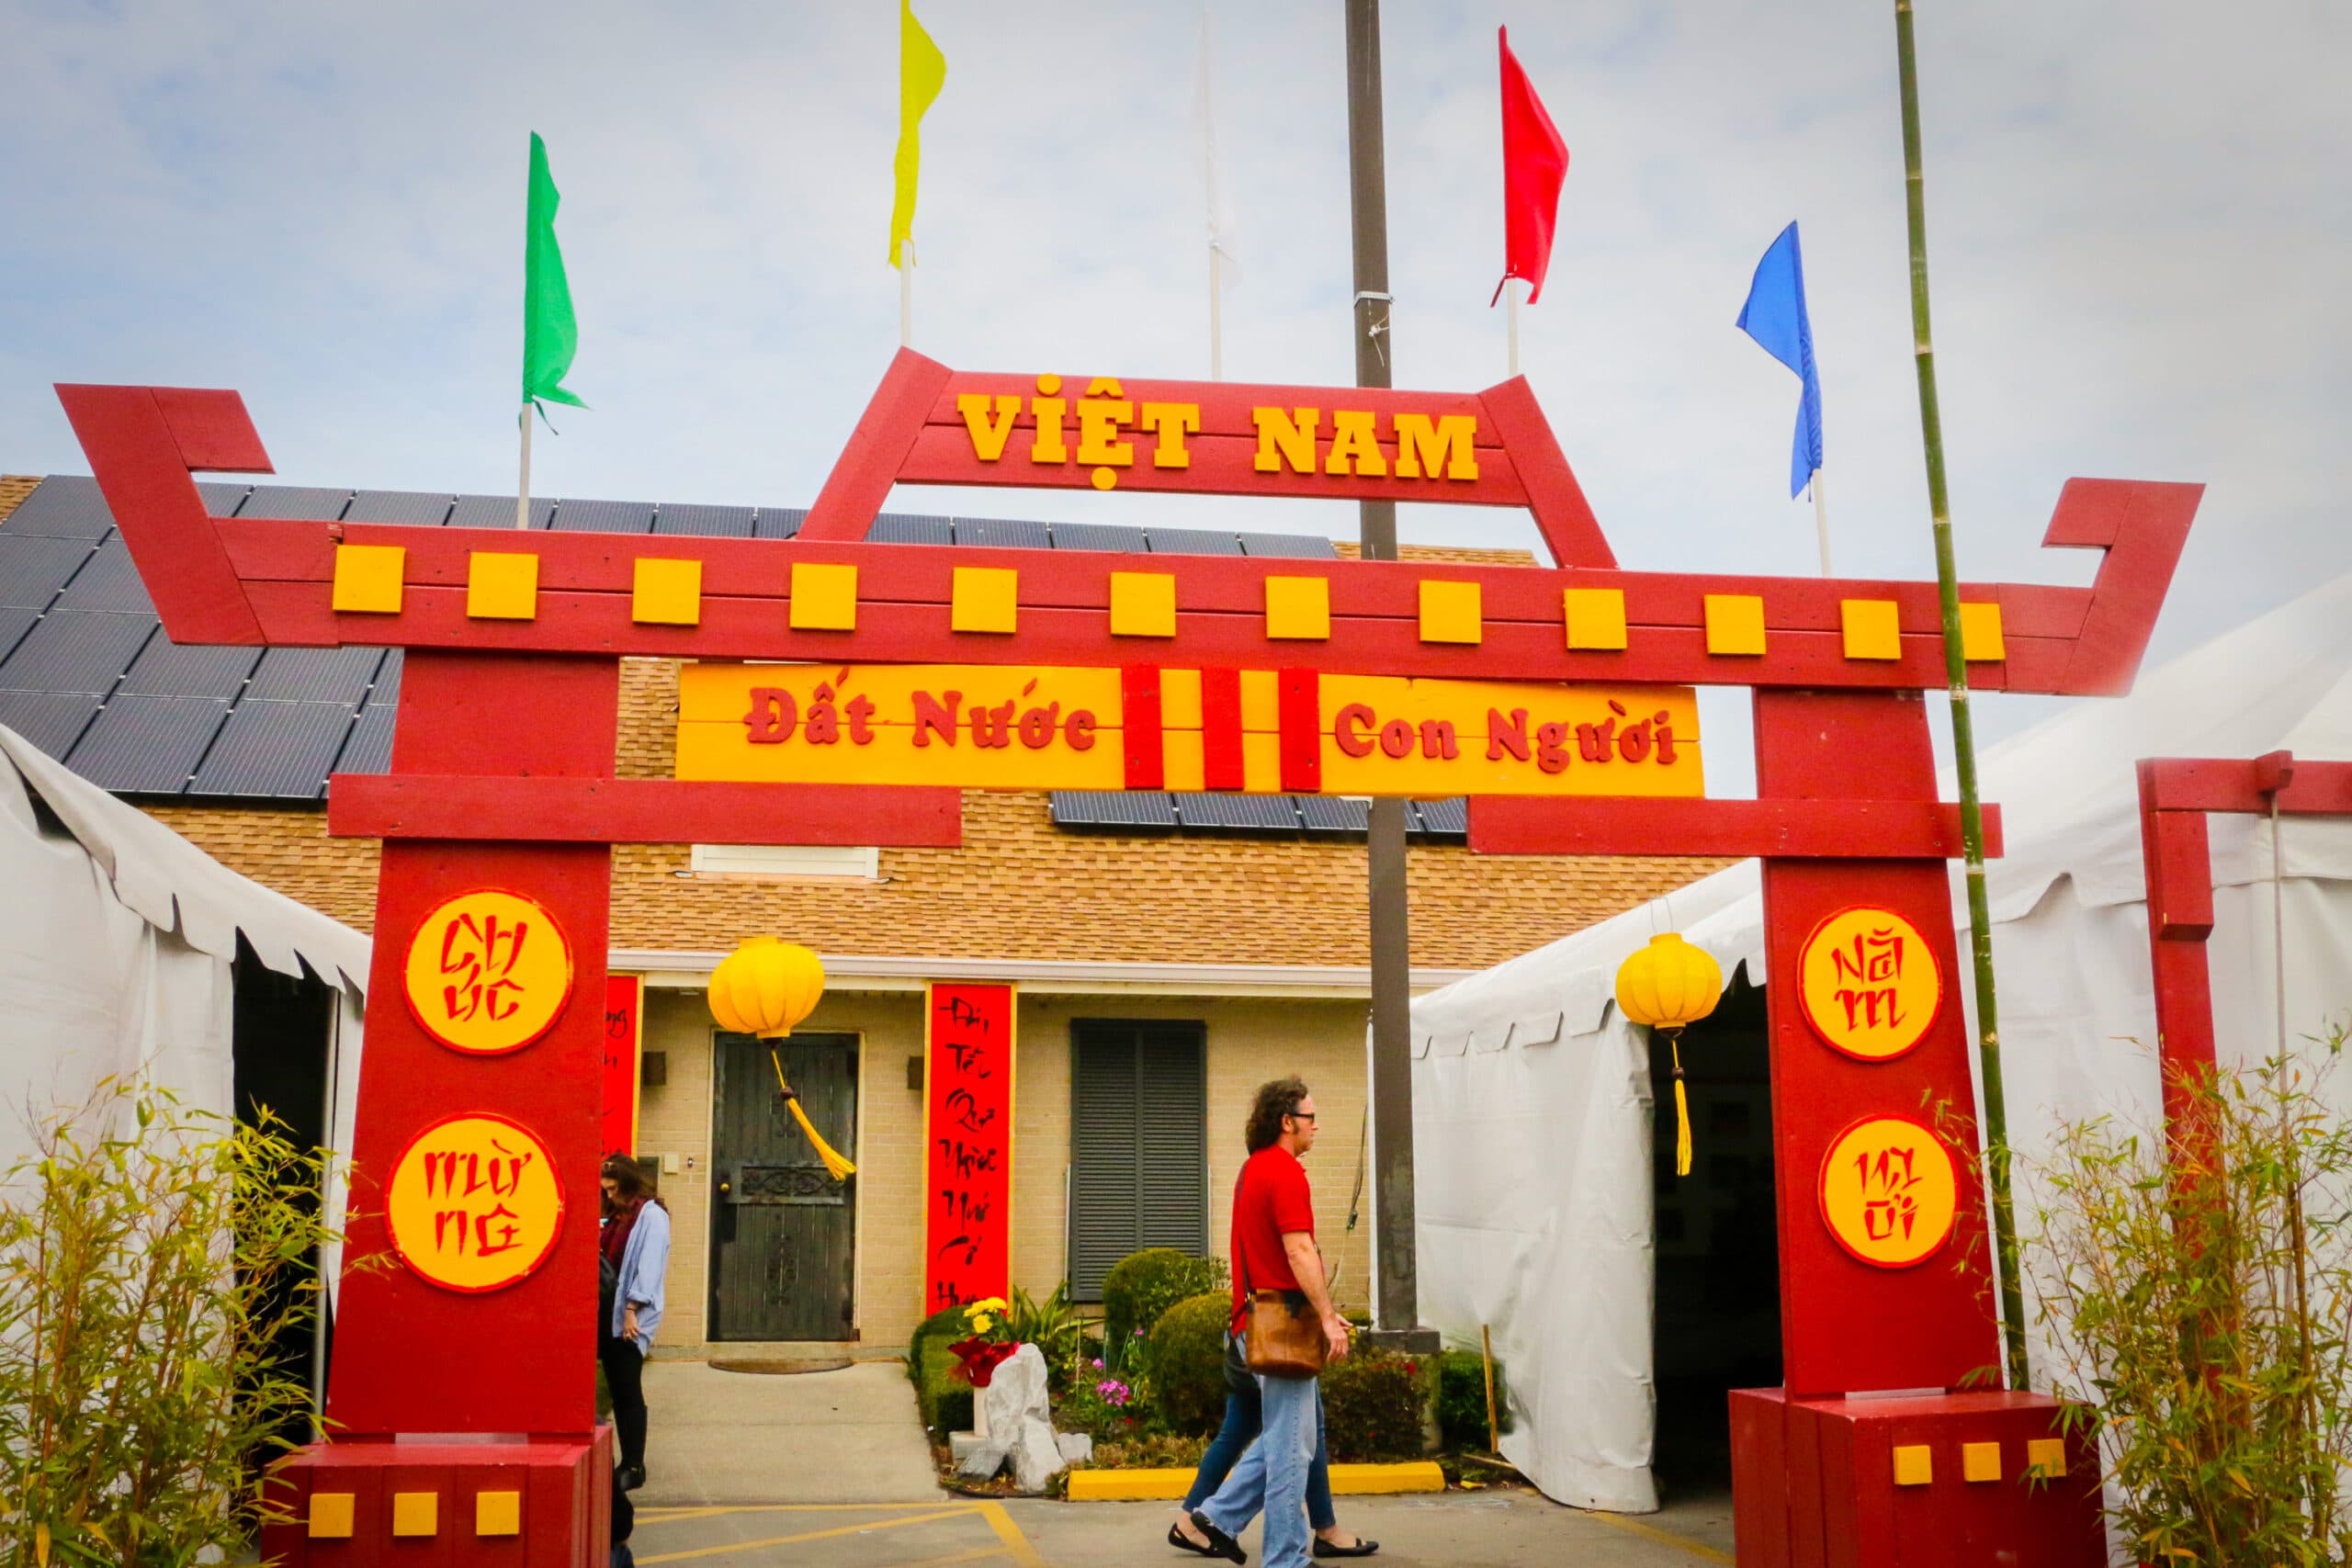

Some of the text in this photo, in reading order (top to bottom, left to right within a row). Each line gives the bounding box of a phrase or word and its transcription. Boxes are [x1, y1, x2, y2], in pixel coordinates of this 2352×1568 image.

[957, 373, 1479, 491] VIỆT NAM
[742, 667, 1096, 750] Đất Nước
[1335, 699, 1679, 773] Con Người
